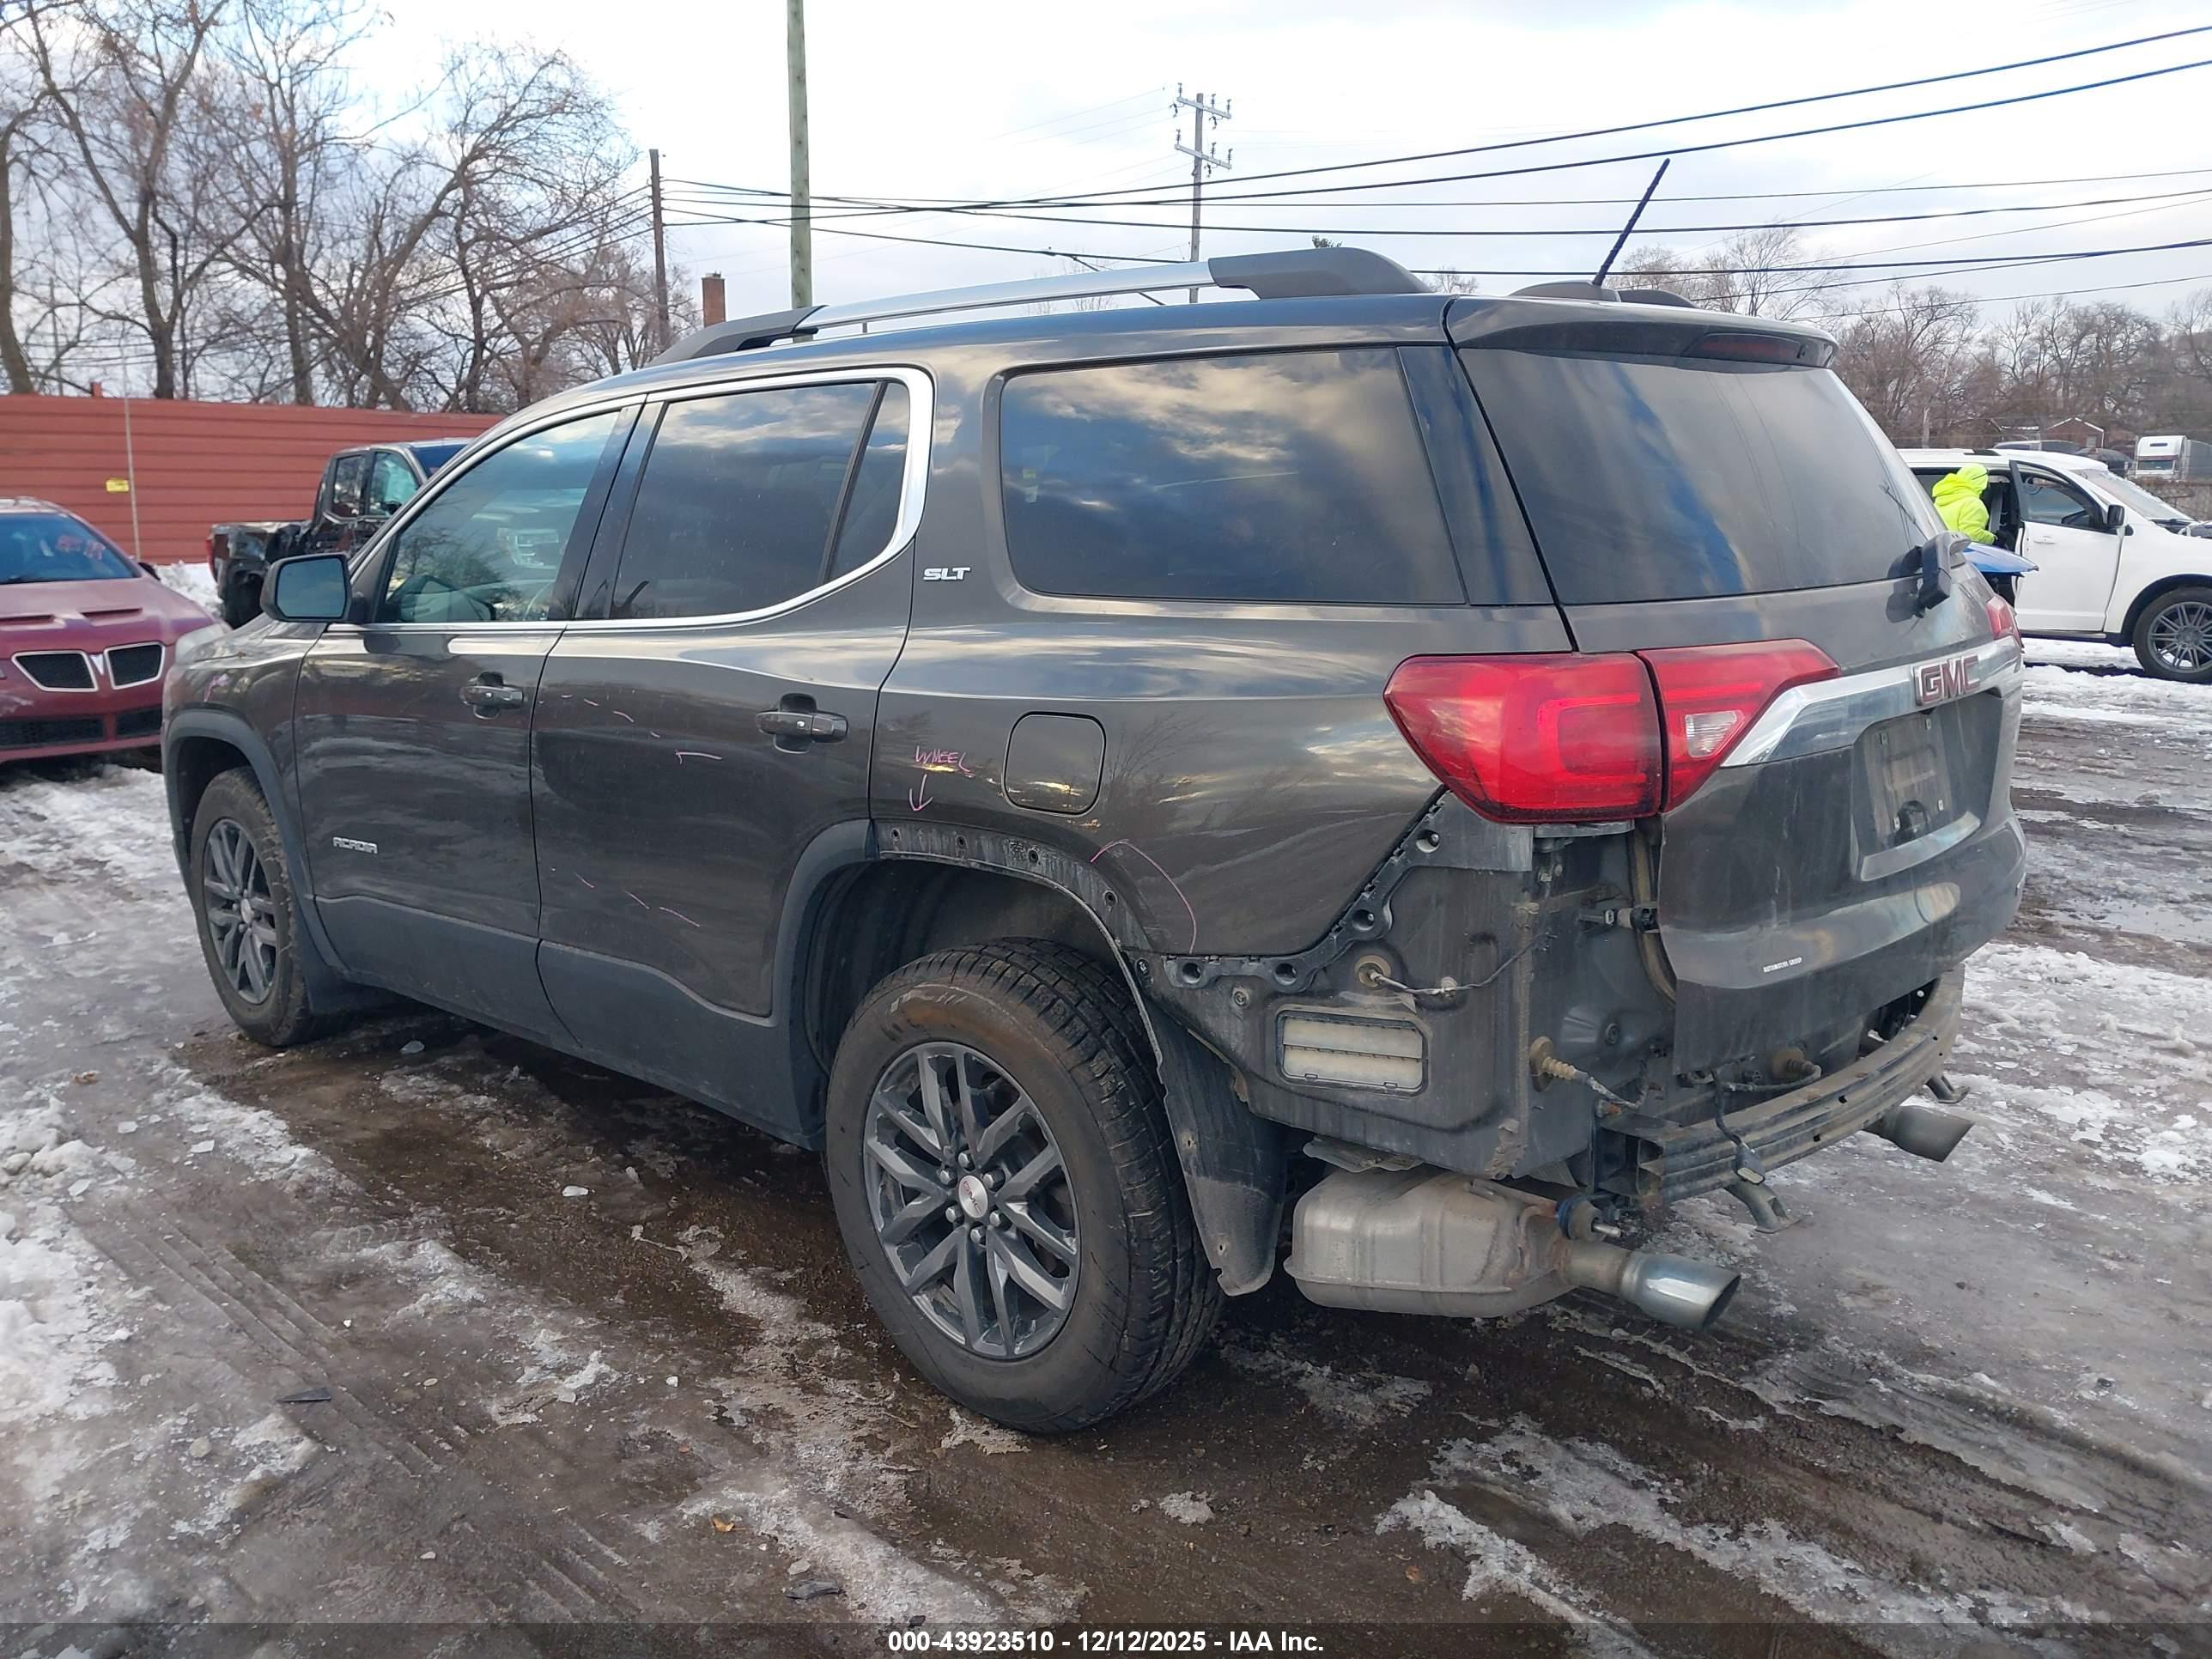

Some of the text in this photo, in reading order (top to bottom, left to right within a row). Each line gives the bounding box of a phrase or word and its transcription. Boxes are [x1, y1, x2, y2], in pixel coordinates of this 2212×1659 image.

[923, 567, 971, 580] SLT
[1918, 653, 1981, 704] GMC
[915, 745, 972, 773] WHEEL
